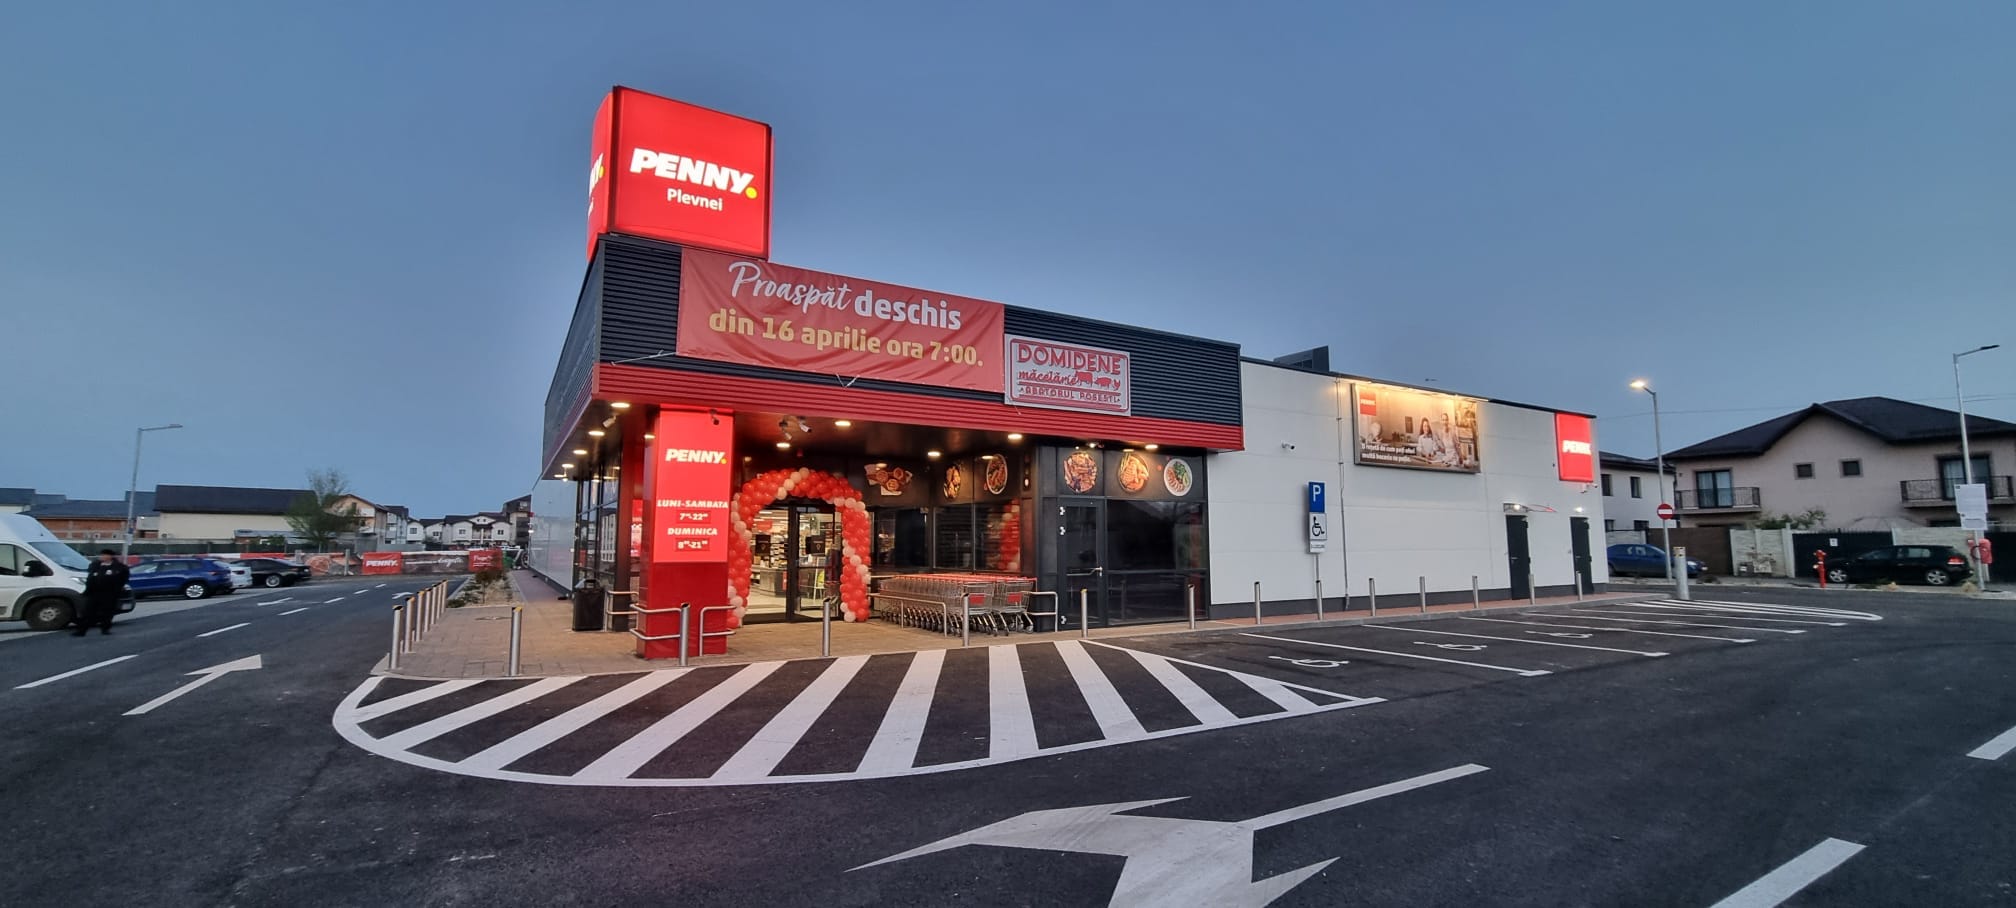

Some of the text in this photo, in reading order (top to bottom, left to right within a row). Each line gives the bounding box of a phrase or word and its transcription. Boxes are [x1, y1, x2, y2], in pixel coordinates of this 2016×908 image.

[667, 188, 723, 211] Plevnei
[728, 261, 961, 330] Proaspăt deschis
[709, 308, 984, 367] din 16 aprilie ora 7:00.
[1018, 343, 1121, 376] DOMIDENE
[1018, 369, 1079, 386] măcelărie
[1312, 484, 1322, 502] P
[657, 499, 729, 509] LUNI-SAMBATA
[667, 527, 718, 536] DUMINICA
